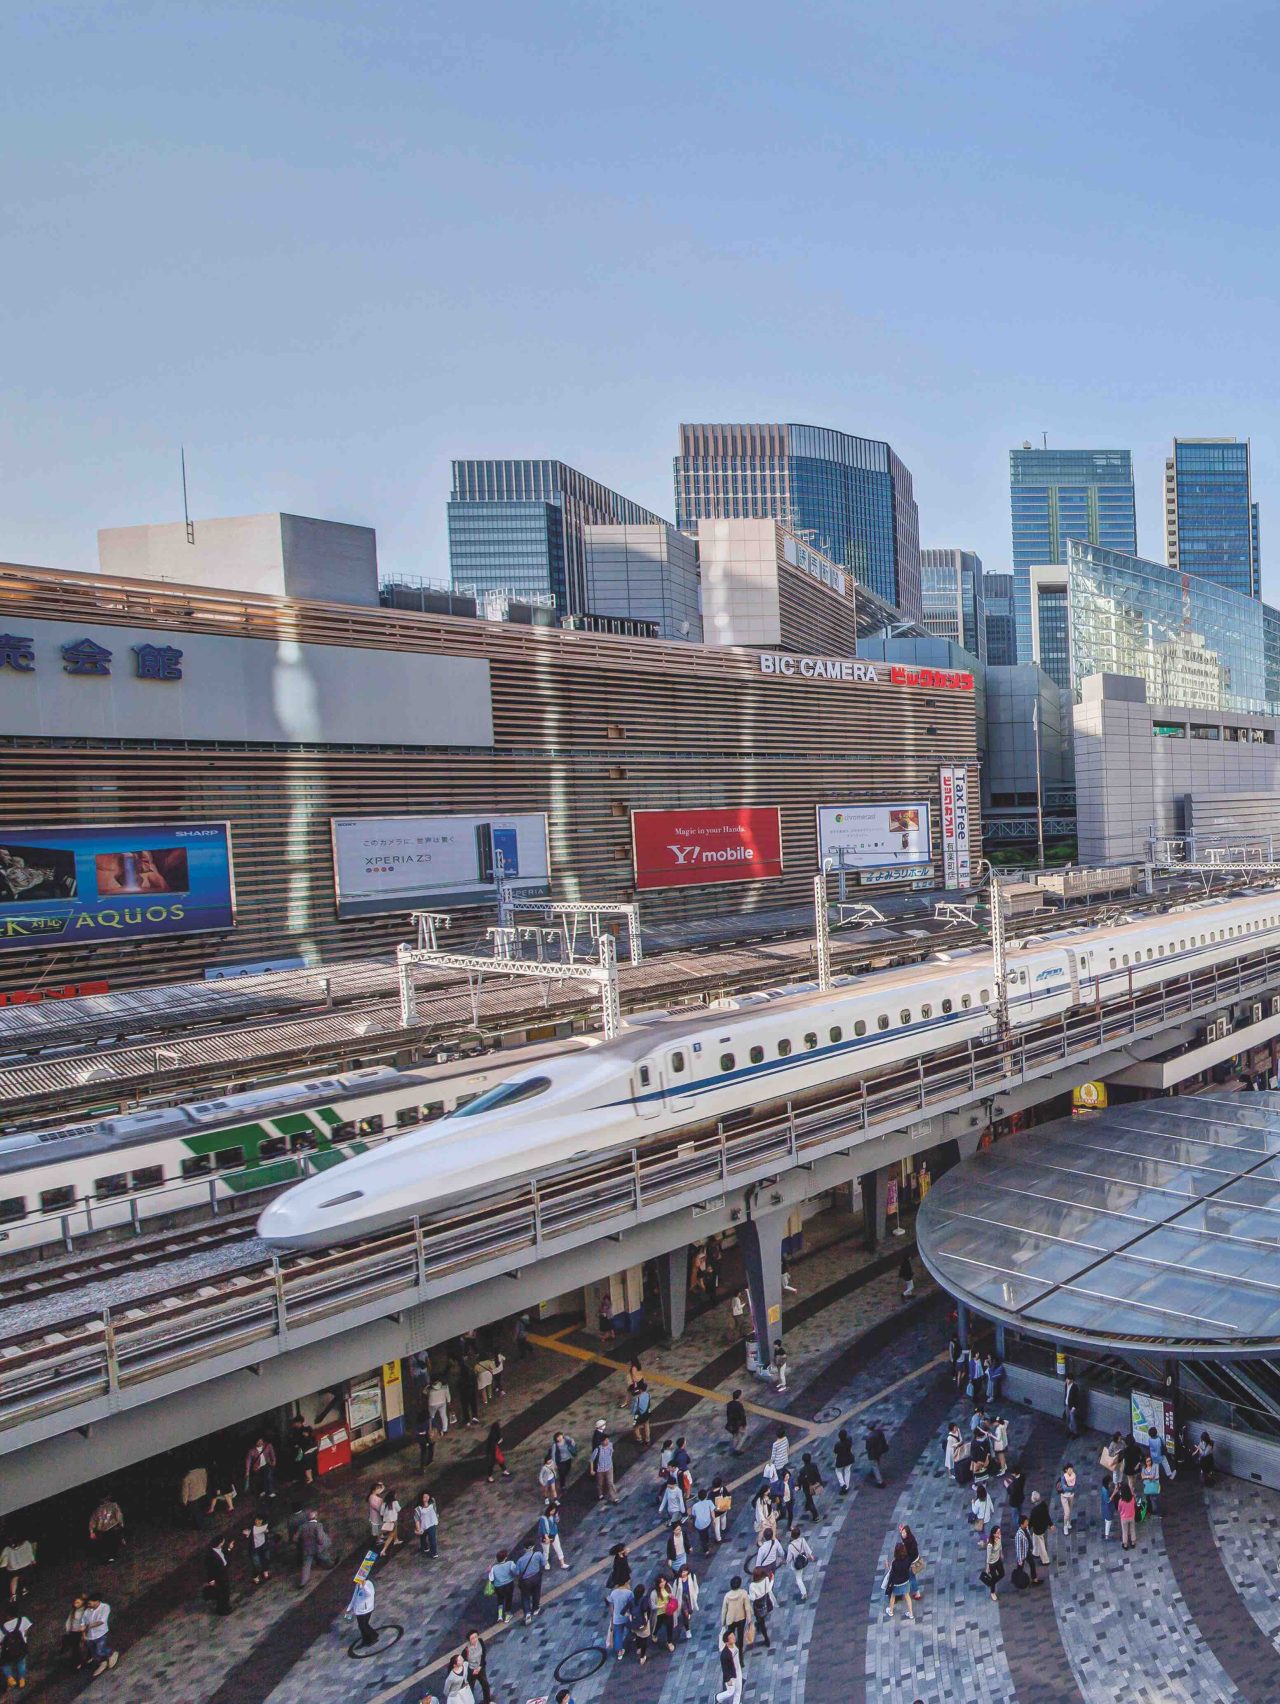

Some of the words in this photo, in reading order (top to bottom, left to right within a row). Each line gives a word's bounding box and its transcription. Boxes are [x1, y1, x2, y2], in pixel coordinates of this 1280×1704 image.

[760, 654, 795, 676] BIC
[799, 657, 879, 683] CAMERA
[889, 665, 975, 691] ビックカメラ
[955, 774, 966, 803] Tax
[943, 776, 954, 839] ビックカメラ
[175, 829, 219, 838] SHARP
[675, 827, 697, 838] Magic
[697, 826, 705, 835] in
[705, 826, 722, 837] your
[956, 806, 968, 841] Free
[365, 856, 414, 866] XPERIA
[416, 854, 432, 864] Z3
[75, 904, 186, 929] AQUOS
